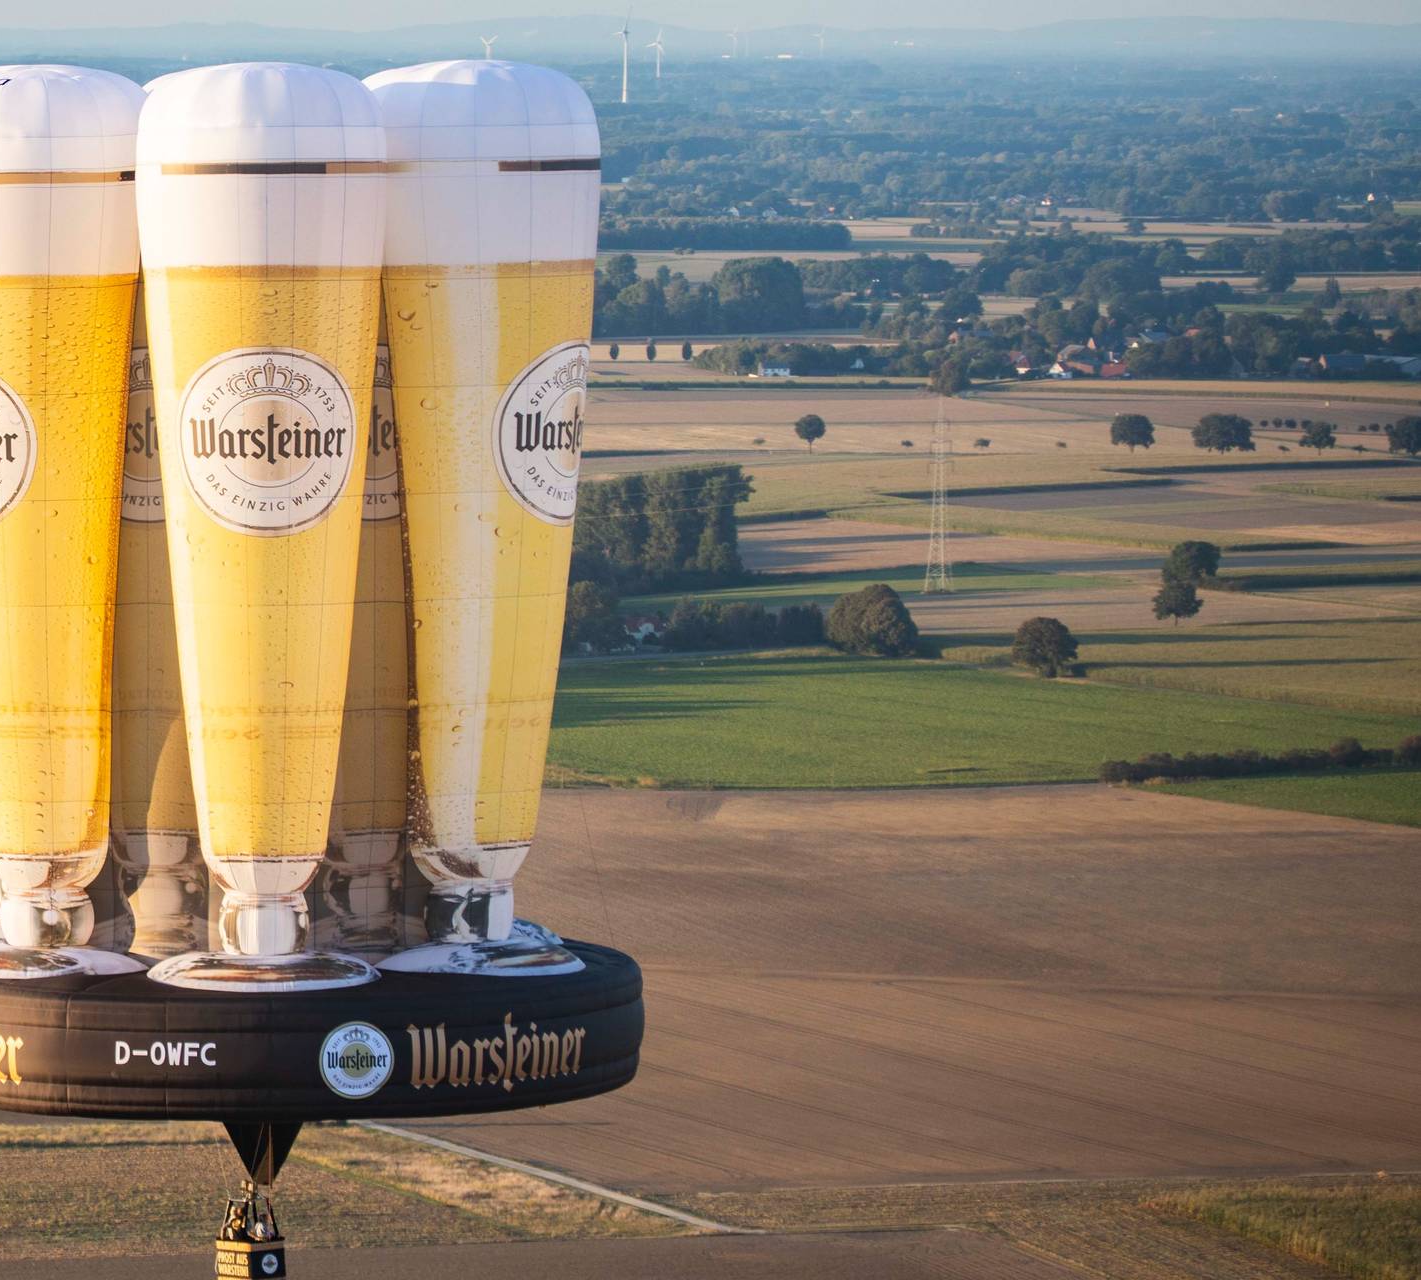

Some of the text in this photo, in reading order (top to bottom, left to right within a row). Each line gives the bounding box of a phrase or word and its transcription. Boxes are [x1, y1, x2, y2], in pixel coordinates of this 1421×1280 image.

[202, 386, 227, 413] SEIT
[314, 386, 336, 412] 1753
[530, 381, 553, 407] SEIT
[189, 413, 347, 465] Warsteiner
[526, 466, 545, 488] DAS
[205, 471, 332, 512] DAS EINZIG WAHRE
[114, 1040, 217, 1067] D-OWFC
[327, 1048, 388, 1071] Warsteiner
[407, 1012, 586, 1092] Warsteiner
